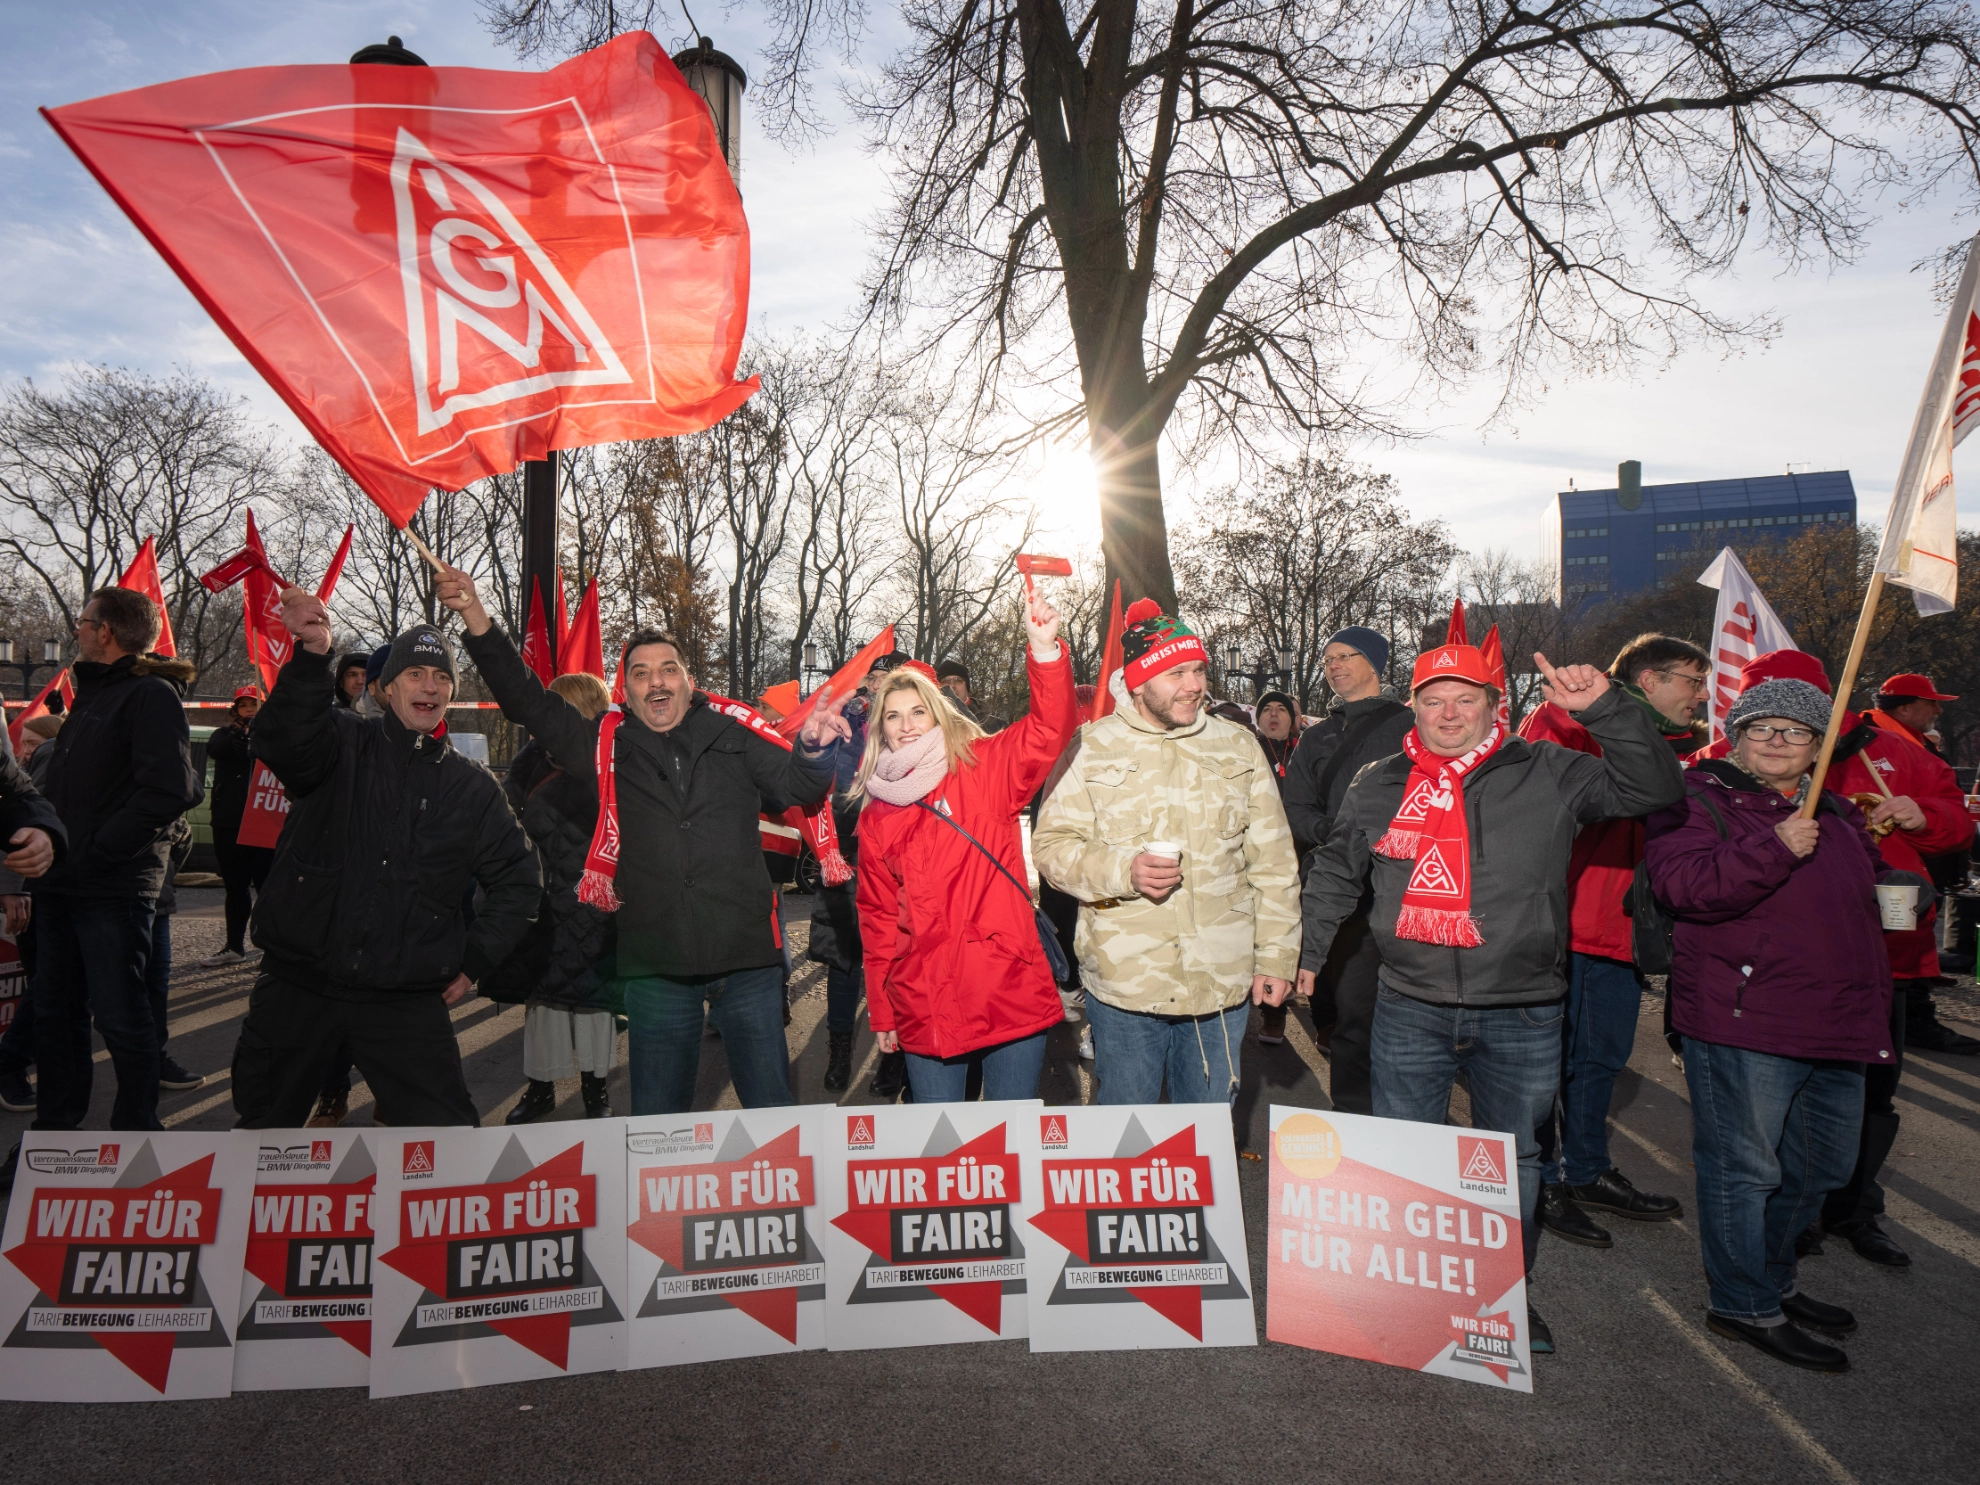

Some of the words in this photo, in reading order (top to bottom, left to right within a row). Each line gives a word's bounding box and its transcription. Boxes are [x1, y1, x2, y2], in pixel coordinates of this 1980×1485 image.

[413, 644, 443, 656] BMW
[1140, 639, 1199, 669] CHRISTMAS
[632, 1136, 693, 1146] Vertrauensleute
[655, 1146, 679, 1155] BMW
[680, 1143, 714, 1153] Dingolfing
[34, 1155, 98, 1164] Vertrauensleute
[54, 1165, 80, 1175] BMW
[80, 1165, 117, 1175] Dingolfing
[266, 1162, 293, 1172] BMW
[293, 1161, 331, 1171] Dingolfing
[402, 1172, 434, 1181] Landshut
[645, 1173, 721, 1213] WIR
[730, 1159, 801, 1207] FÜR
[854, 1168, 927, 1205] WIR
[937, 1156, 1007, 1202] FÜR
[1048, 1168, 1123, 1205] WIR
[1130, 1157, 1200, 1203] FÜR
[1459, 1180, 1508, 1196] Landshut
[36, 1199, 115, 1238] WIR
[122, 1189, 203, 1239] FÜR
[254, 1194, 333, 1234] WIR
[407, 1195, 491, 1239] WIR
[503, 1179, 580, 1230] FÜR
[1281, 1182, 1391, 1233] MEHR
[1404, 1201, 1508, 1250] GELD
[694, 1213, 798, 1262] FAIR!
[901, 1209, 1003, 1253] FAIR!
[1098, 1213, 1200, 1254] FAIR!
[71, 1251, 191, 1295] FAIR!
[298, 1244, 374, 1287] FAI
[459, 1235, 575, 1288] FAIR!
[870, 1266, 964, 1284] TARIFBEWEGUNG
[967, 1262, 1026, 1279] LEIHARBEIT
[1281, 1222, 1353, 1275] FÜR
[1366, 1243, 1477, 1297] ALLE!
[661, 1273, 759, 1295] TARIFBEWEGUNG
[761, 1266, 821, 1286] LEIHARBEIT
[1069, 1269, 1163, 1285] TARIFBEWEGUNG
[1165, 1267, 1224, 1282] LEIHARBEIT
[33, 1312, 135, 1328] TARIFBEWEGUNG
[137, 1312, 208, 1328] LEIHARBEIT
[260, 1302, 366, 1319] TARIFBEWEGUNG
[422, 1298, 529, 1323] TARIFBEWEGUNG
[532, 1290, 599, 1311] LEIHARBEIT
[1450, 1314, 1479, 1333] WIR
[1481, 1319, 1509, 1338] FÜR
[1467, 1333, 1509, 1355] FAIR!
